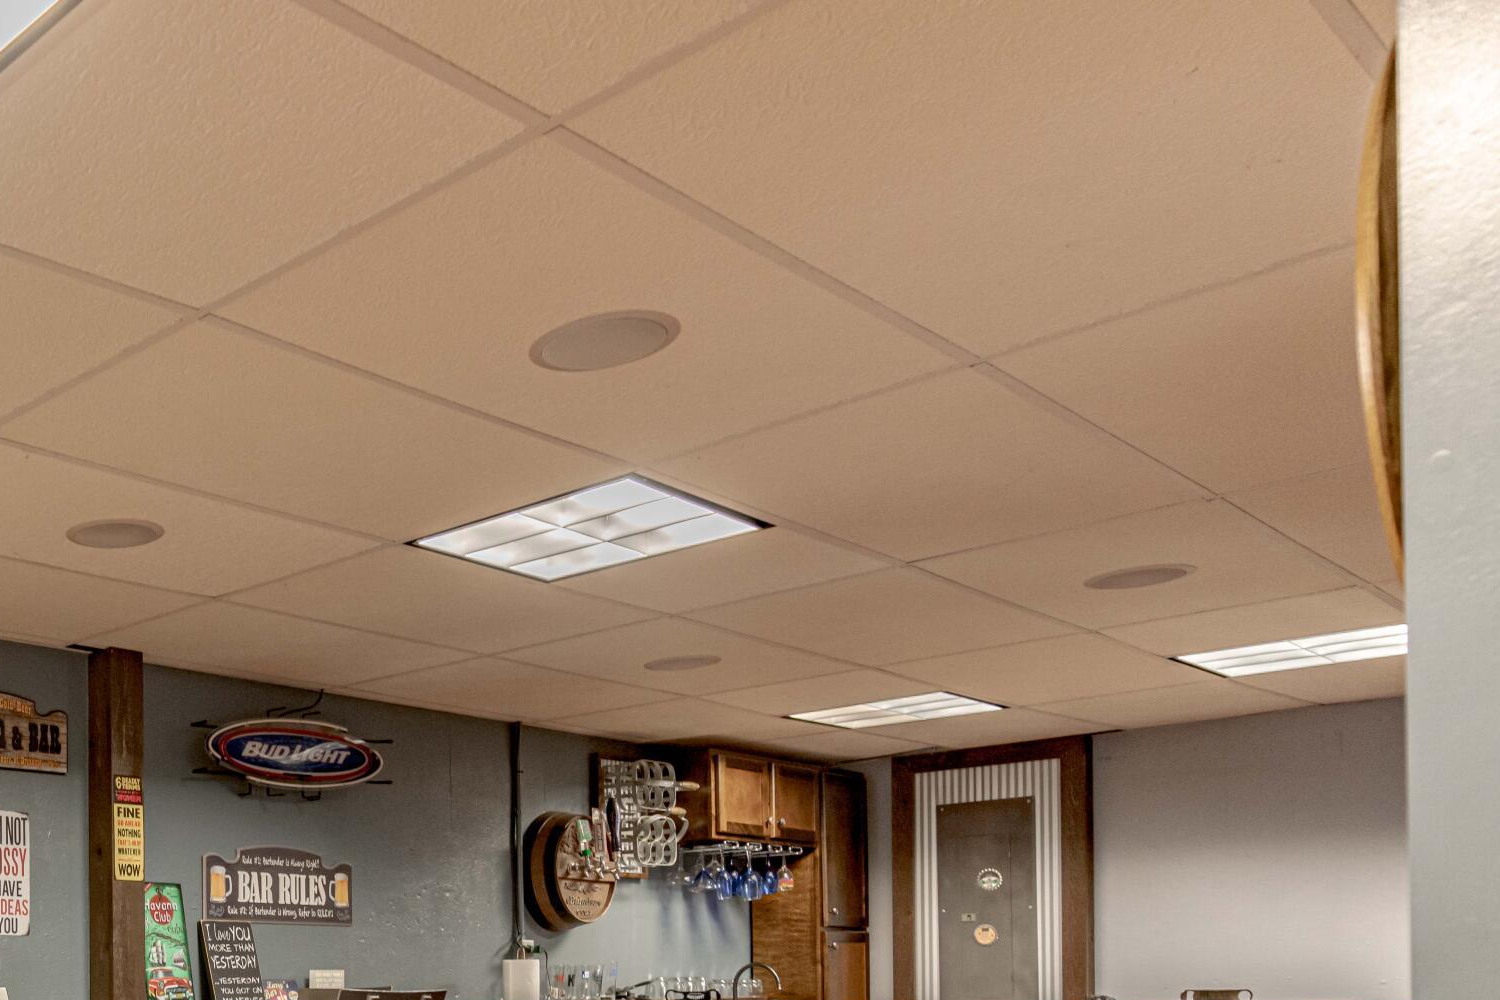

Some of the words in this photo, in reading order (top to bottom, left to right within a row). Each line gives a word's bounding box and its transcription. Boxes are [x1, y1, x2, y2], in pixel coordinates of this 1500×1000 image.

[28, 722, 62, 754] BAR
[242, 741, 291, 760] BUD
[290, 744, 351, 764] LIGHT
[117, 806, 140, 818] FINE
[5, 816, 27, 846] NOT
[118, 828, 141, 838] NOTHING
[118, 863, 141, 877] WOW
[237, 870, 273, 904] BAR
[278, 873, 327, 906] RULES
[153, 911, 171, 922] Club
[205, 924, 212, 941] I
[229, 925, 252, 941] YOU
[208, 943, 232, 952] MORE
[234, 943, 254, 952] THAN
[211, 955, 256, 969] YESTERDAY
[253, 986, 263, 994] ON
